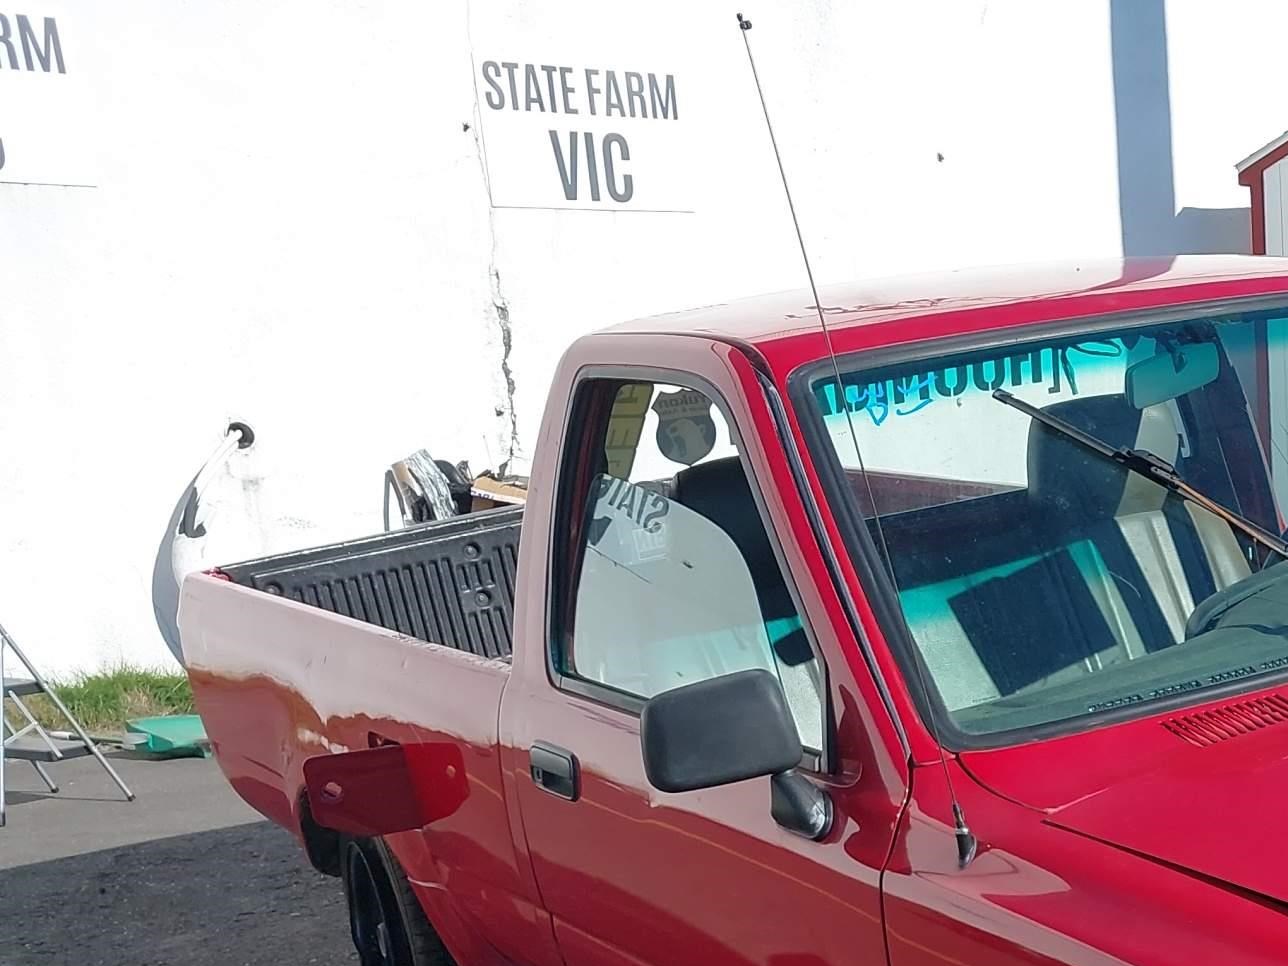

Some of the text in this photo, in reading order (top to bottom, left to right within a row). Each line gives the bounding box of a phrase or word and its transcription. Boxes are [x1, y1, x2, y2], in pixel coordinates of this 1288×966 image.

[482, 60, 679, 121] STATE FARM
[548, 129, 634, 204] VIC
